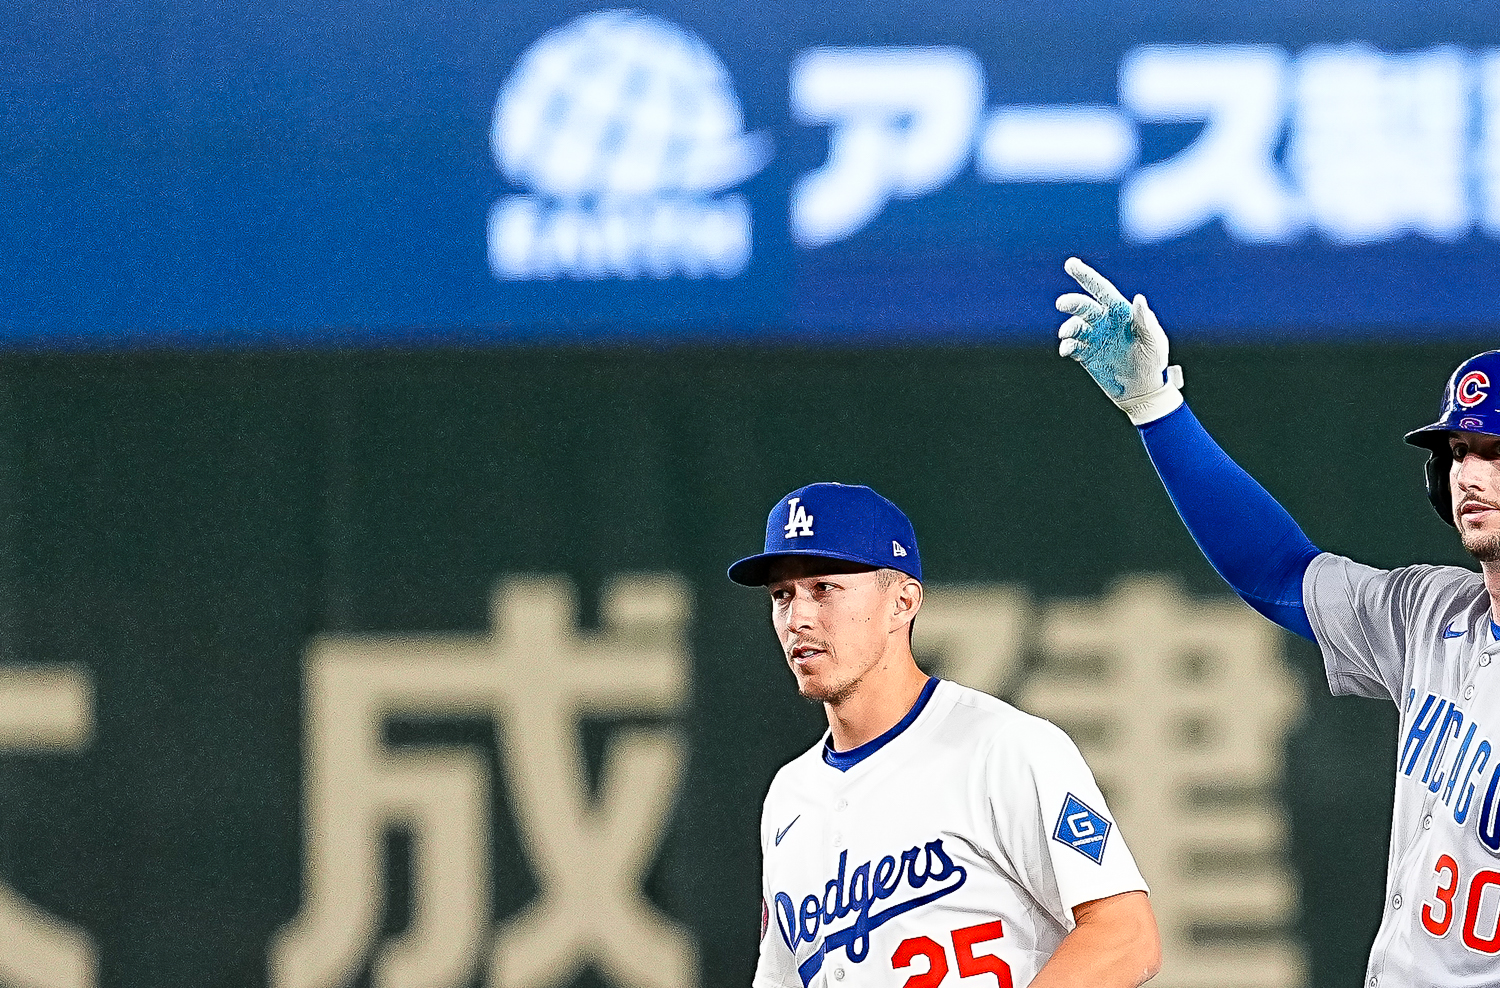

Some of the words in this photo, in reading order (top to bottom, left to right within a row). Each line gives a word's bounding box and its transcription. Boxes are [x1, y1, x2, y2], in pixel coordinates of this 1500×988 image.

[1456, 371, 1490, 407] C
[785, 498, 814, 539] LA
[1066, 811, 1095, 839] G
[774, 838, 967, 968] Dodgers
